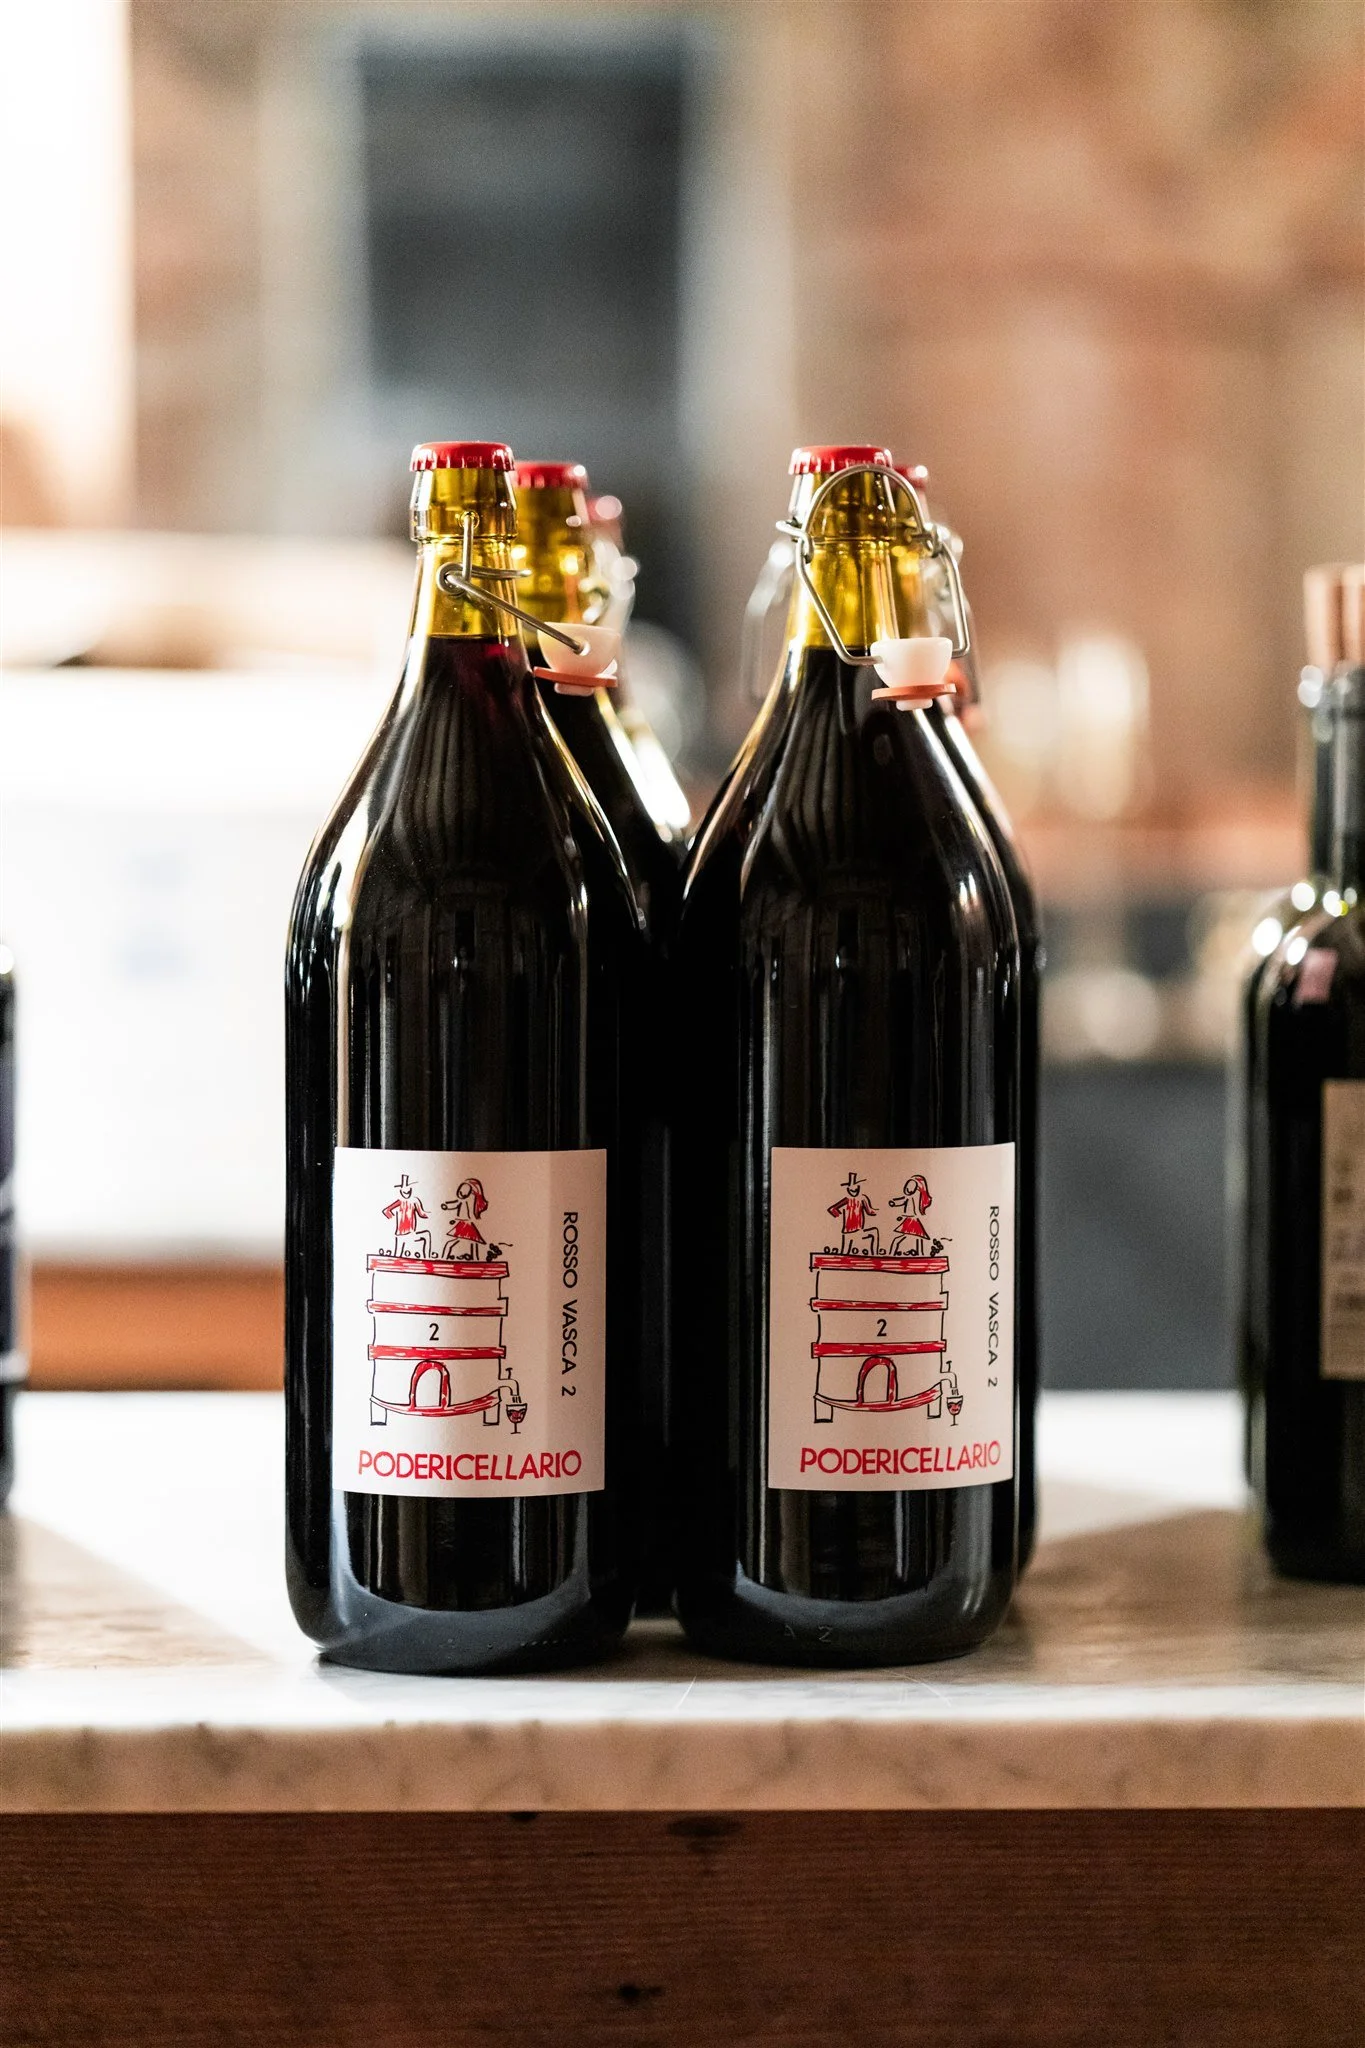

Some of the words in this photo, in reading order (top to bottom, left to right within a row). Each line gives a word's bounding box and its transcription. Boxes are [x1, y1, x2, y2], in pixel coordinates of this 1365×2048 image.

[562, 1211, 579, 1289] ROSSO
[989, 1205, 1000, 1281] ROSSO
[428, 1322, 440, 1342] 2
[561, 1298, 578, 1375] VASCA
[876, 1318, 888, 1338] 2
[988, 1291, 1000, 1366] VASCA
[561, 1386, 577, 1397] 2
[987, 1377, 998, 1387] 2
[358, 1449, 583, 1481] PODERICELLARIO
[800, 1440, 1001, 1475] PODERICELLARIO
